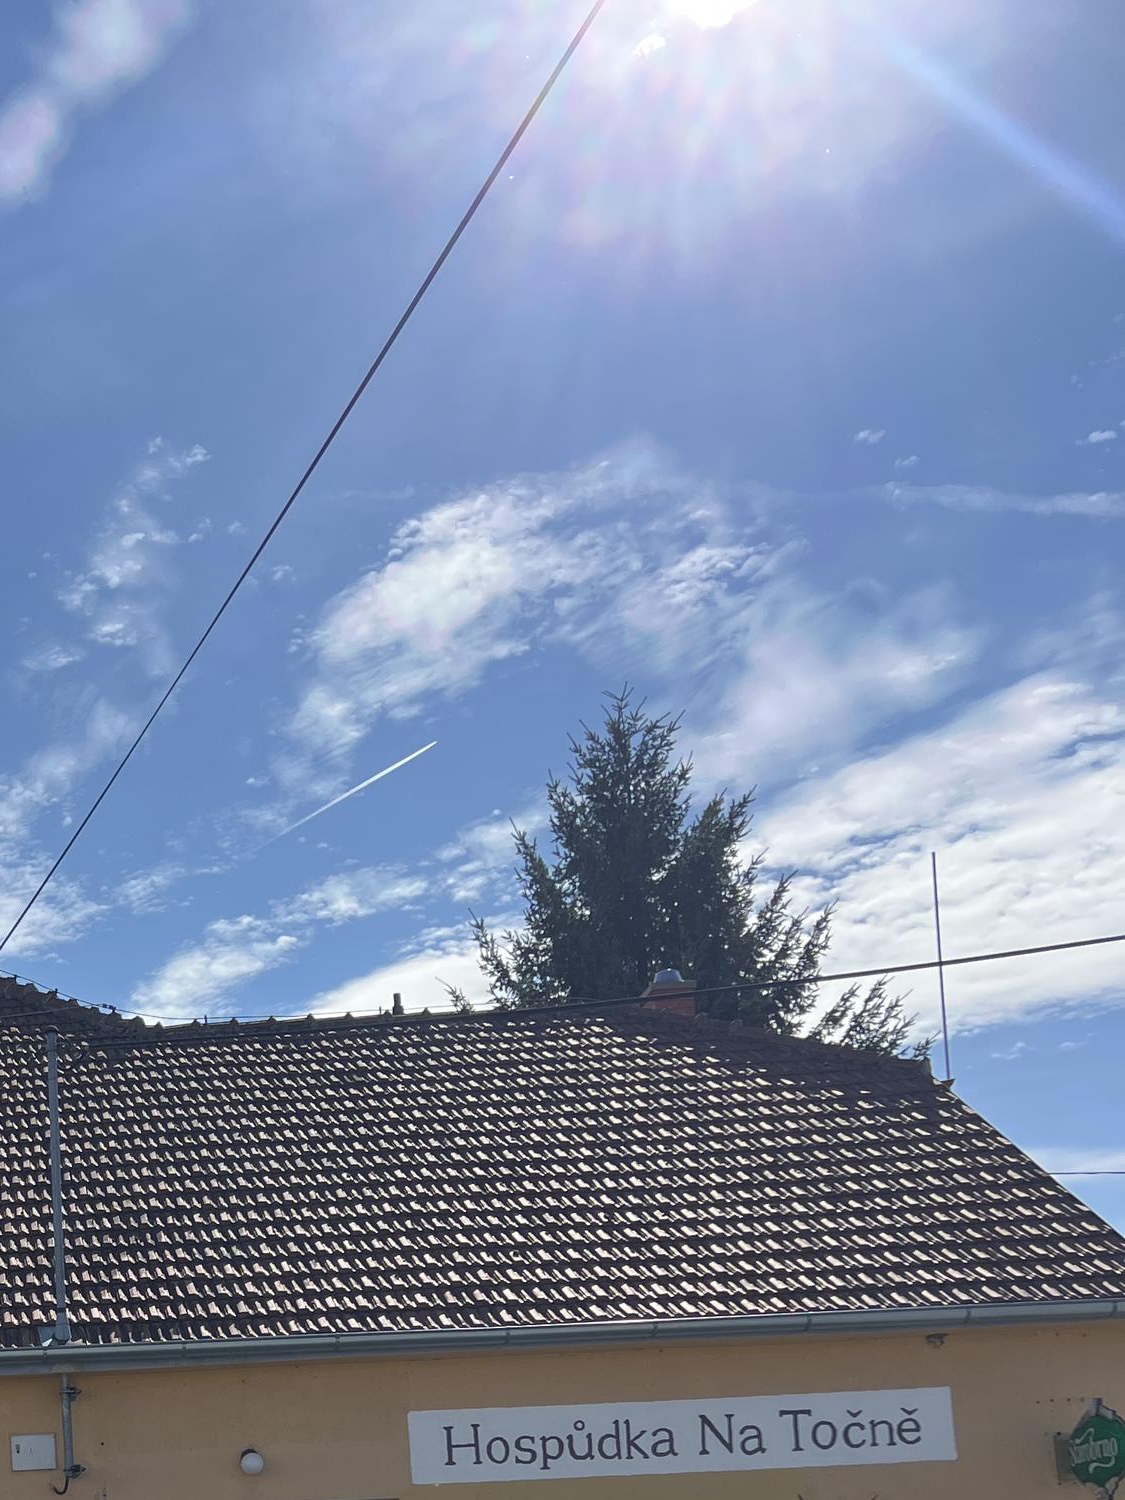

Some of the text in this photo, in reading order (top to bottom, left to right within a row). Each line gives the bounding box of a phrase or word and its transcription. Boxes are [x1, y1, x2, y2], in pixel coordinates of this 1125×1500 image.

[442, 1407, 925, 1470] Hospůdka Na Točně
